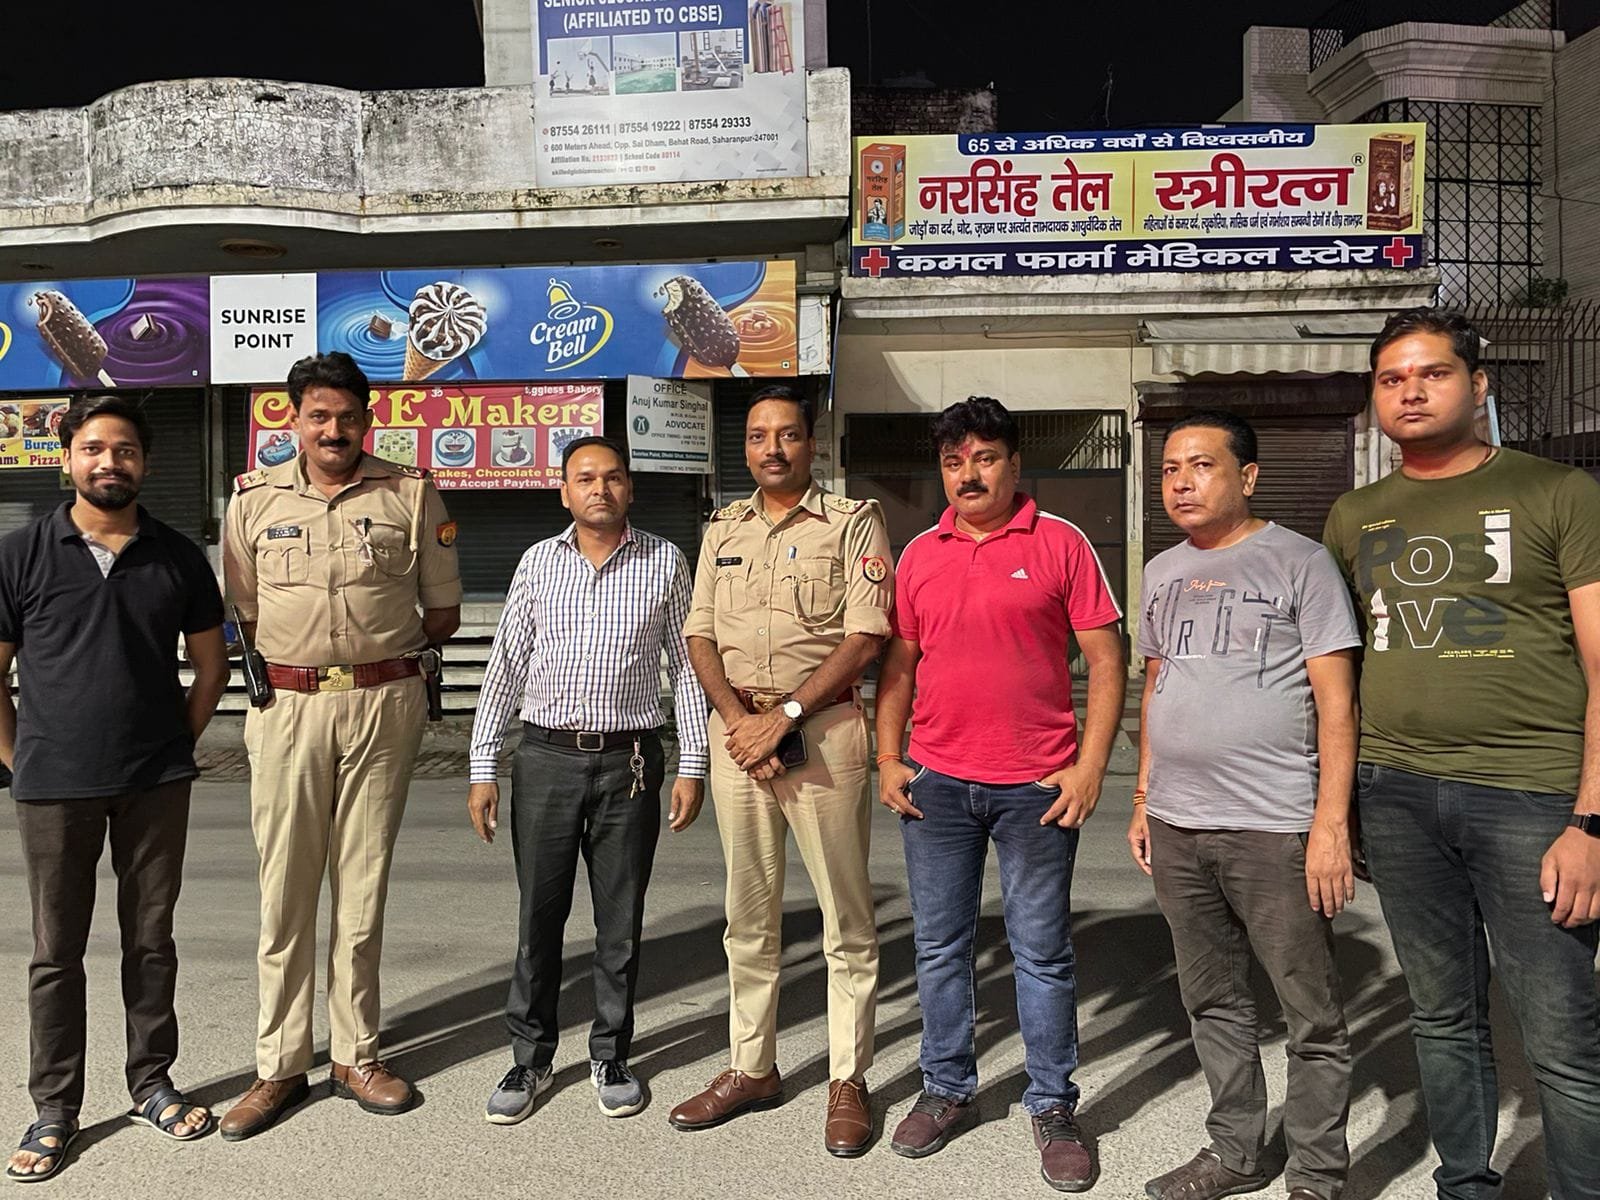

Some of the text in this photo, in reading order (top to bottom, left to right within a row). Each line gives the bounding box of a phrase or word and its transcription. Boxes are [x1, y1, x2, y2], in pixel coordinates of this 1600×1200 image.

[563, 5, 722, 33] (AFFILIATED TO CBSE)
[550, 117, 751, 136] 87554 26111 87554 19222 87554 29333
[551, 143, 563, 151] 600
[967, 130, 1305, 152] 65 से अधिक वर्षों से विश्वसनीय
[918, 158, 1113, 217] नरसिंह तेल
[1154, 152, 1355, 211] स्त्रीरत्न
[929, 223, 939, 235] का
[996, 221, 1007, 234] पर
[1032, 220, 1070, 233] लाभदायक
[1109, 216, 1122, 231] तेल
[896, 240, 1379, 272] कमल फार्मा मेडिकल स्टोर
[221, 309, 306, 324] SUNRISE
[530, 315, 598, 345] Cream
[234, 333, 294, 349] POINT
[547, 333, 587, 364] Bell
[567, 384, 602, 396] Bakery
[654, 383, 688, 395] OFFICE
[253, 389, 600, 429] CE Makers
[632, 395, 708, 413] Anuj Kumar Singhal
[665, 420, 706, 431] ADVOCATE
[24, 439, 61, 452] Burge
[30, 455, 61, 465] Pizza
[475, 468, 541, 478] Chocolate
[545, 468, 563, 477] Bo
[439, 479, 456, 488] We
[460, 479, 499, 489] Accept
[504, 478, 545, 489] Paytm,
